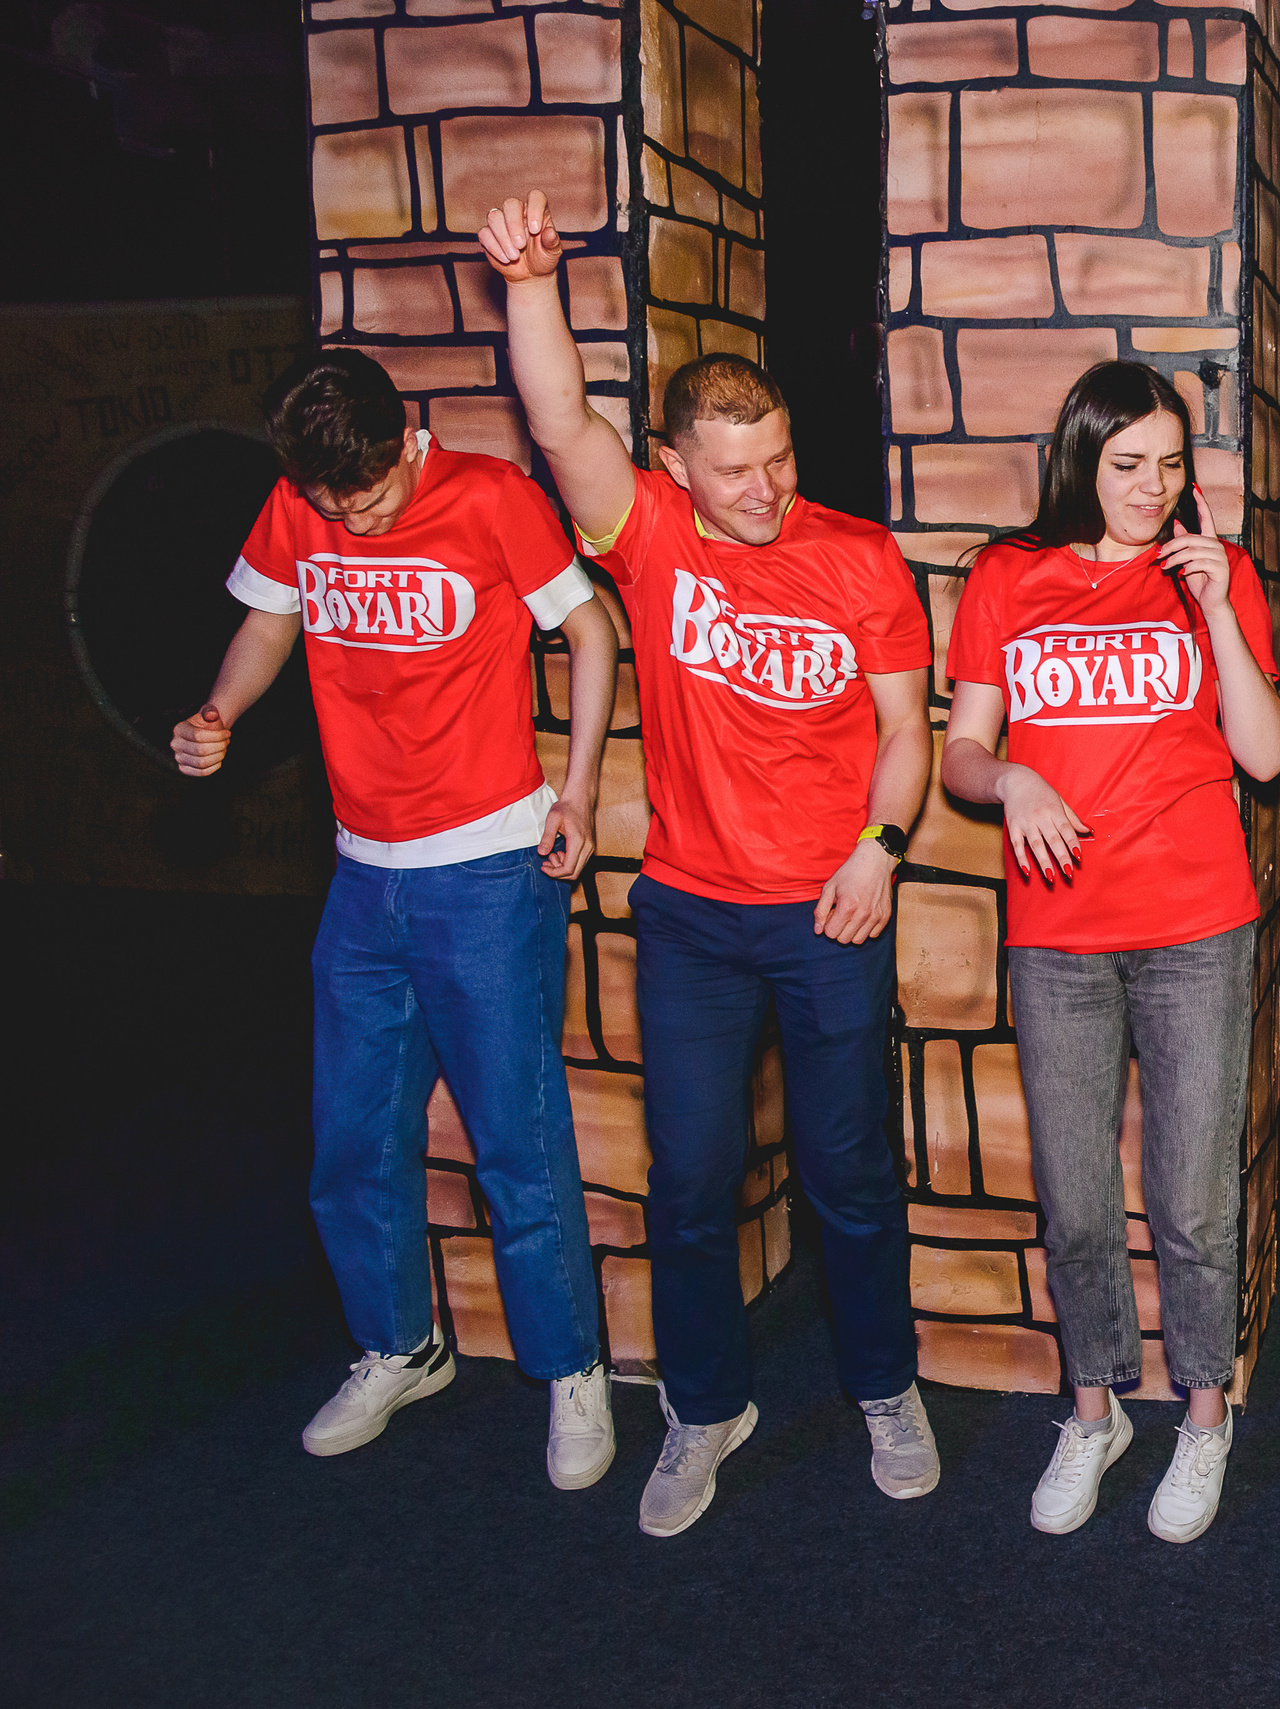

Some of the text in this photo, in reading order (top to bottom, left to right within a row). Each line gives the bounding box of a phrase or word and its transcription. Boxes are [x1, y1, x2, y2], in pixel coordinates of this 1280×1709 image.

[64, 385, 172, 441] TOKIO
[295, 560, 476, 643] BOYARD
[327, 567, 415, 588] FORT
[670, 568, 858, 700] BOYARD
[1043, 632, 1149, 653] FORT
[1000, 631, 1203, 723] BOYARD
